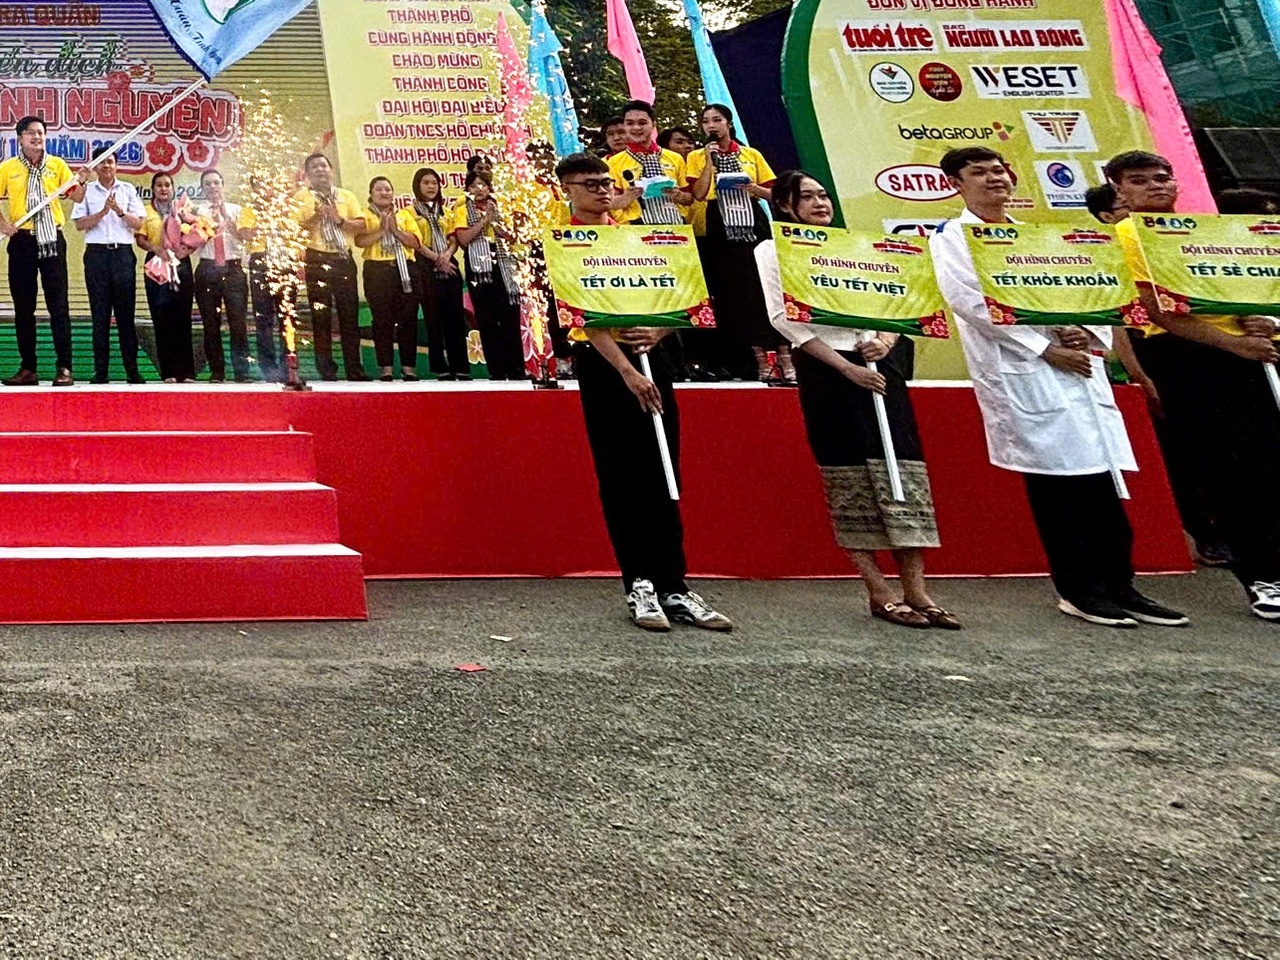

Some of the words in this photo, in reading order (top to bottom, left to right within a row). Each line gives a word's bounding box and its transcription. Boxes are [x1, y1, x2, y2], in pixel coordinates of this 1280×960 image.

[387, 7, 438, 23] THÀNH
[441, 4, 473, 23] PHỐ
[368, 28, 411, 46] CÙNG
[413, 29, 453, 46] HÀNH
[999, 29, 1035, 47] LAO
[1035, 27, 1085, 47] ĐỘNG
[392, 51, 436, 68] CHÀO
[392, 75, 445, 91] THÀNH
[447, 74, 489, 91] CÔNG
[971, 66, 1079, 89] WESET
[382, 99, 410, 116] ĐẠI
[412, 98, 439, 116] HỘI
[441, 99, 469, 116] ĐẠI
[364, 121, 406, 138] ĐOÀN
[407, 123, 446, 138] TNCS
[446, 118, 468, 138] HỒ
[365, 145, 415, 163] THÀNH
[417, 142, 449, 163] PHỐ
[450, 142, 472, 162] HỒ
[887, 173, 951, 192] SATRA
[1202, 244, 1233, 258] HÌNH
[582, 254, 601, 269] ĐỘI
[601, 255, 627, 267] HÌNH
[628, 254, 668, 267] CHUYÊN
[811, 255, 829, 269] ĐỘI
[830, 257, 856, 270] HÌNH
[858, 261, 900, 274] CHUYÊN
[1005, 254, 1023, 268] ĐỘI
[1024, 254, 1051, 266] HÌNH
[1051, 254, 1093, 266] CHUYÊN
[1186, 261, 1218, 278] TẾT
[581, 272, 608, 288] TẾT
[609, 275, 627, 288] ƠI
[629, 273, 648, 288] LÀ
[649, 272, 676, 288] TẾT
[810, 273, 840, 290] YÊU
[842, 276, 872, 293] TẾT
[873, 281, 907, 297] VIỆT
[991, 271, 1019, 287] TẾT
